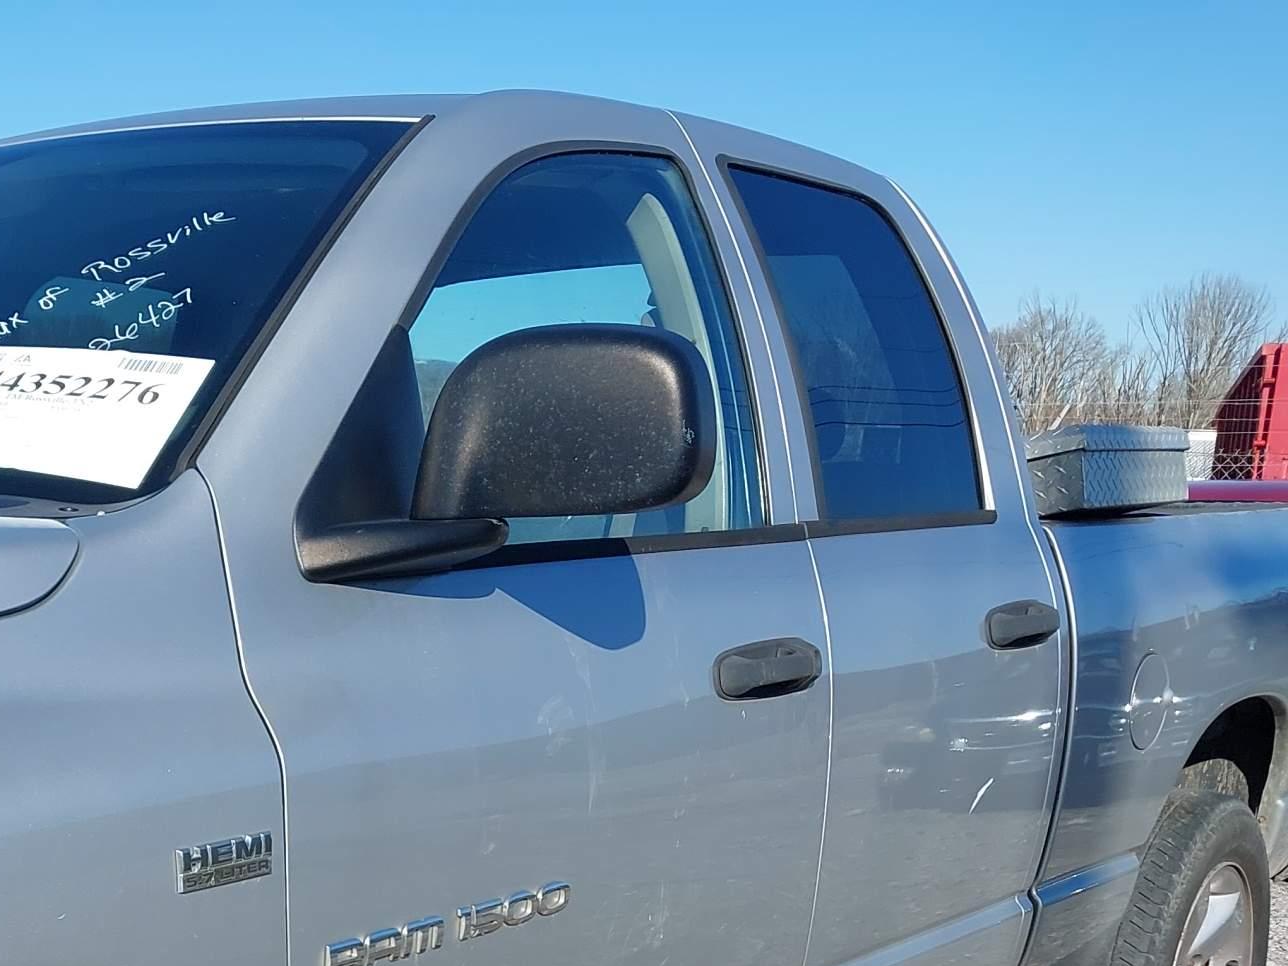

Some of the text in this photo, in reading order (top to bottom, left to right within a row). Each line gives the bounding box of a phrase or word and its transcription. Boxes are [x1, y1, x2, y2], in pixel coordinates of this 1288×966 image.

[38, 286, 70, 310] of
[80, 211, 237, 281] Rossville
[88, 287, 193, 351] 26427
[175, 831, 273, 874] HEMI
[457, 880, 571, 941] 1500
